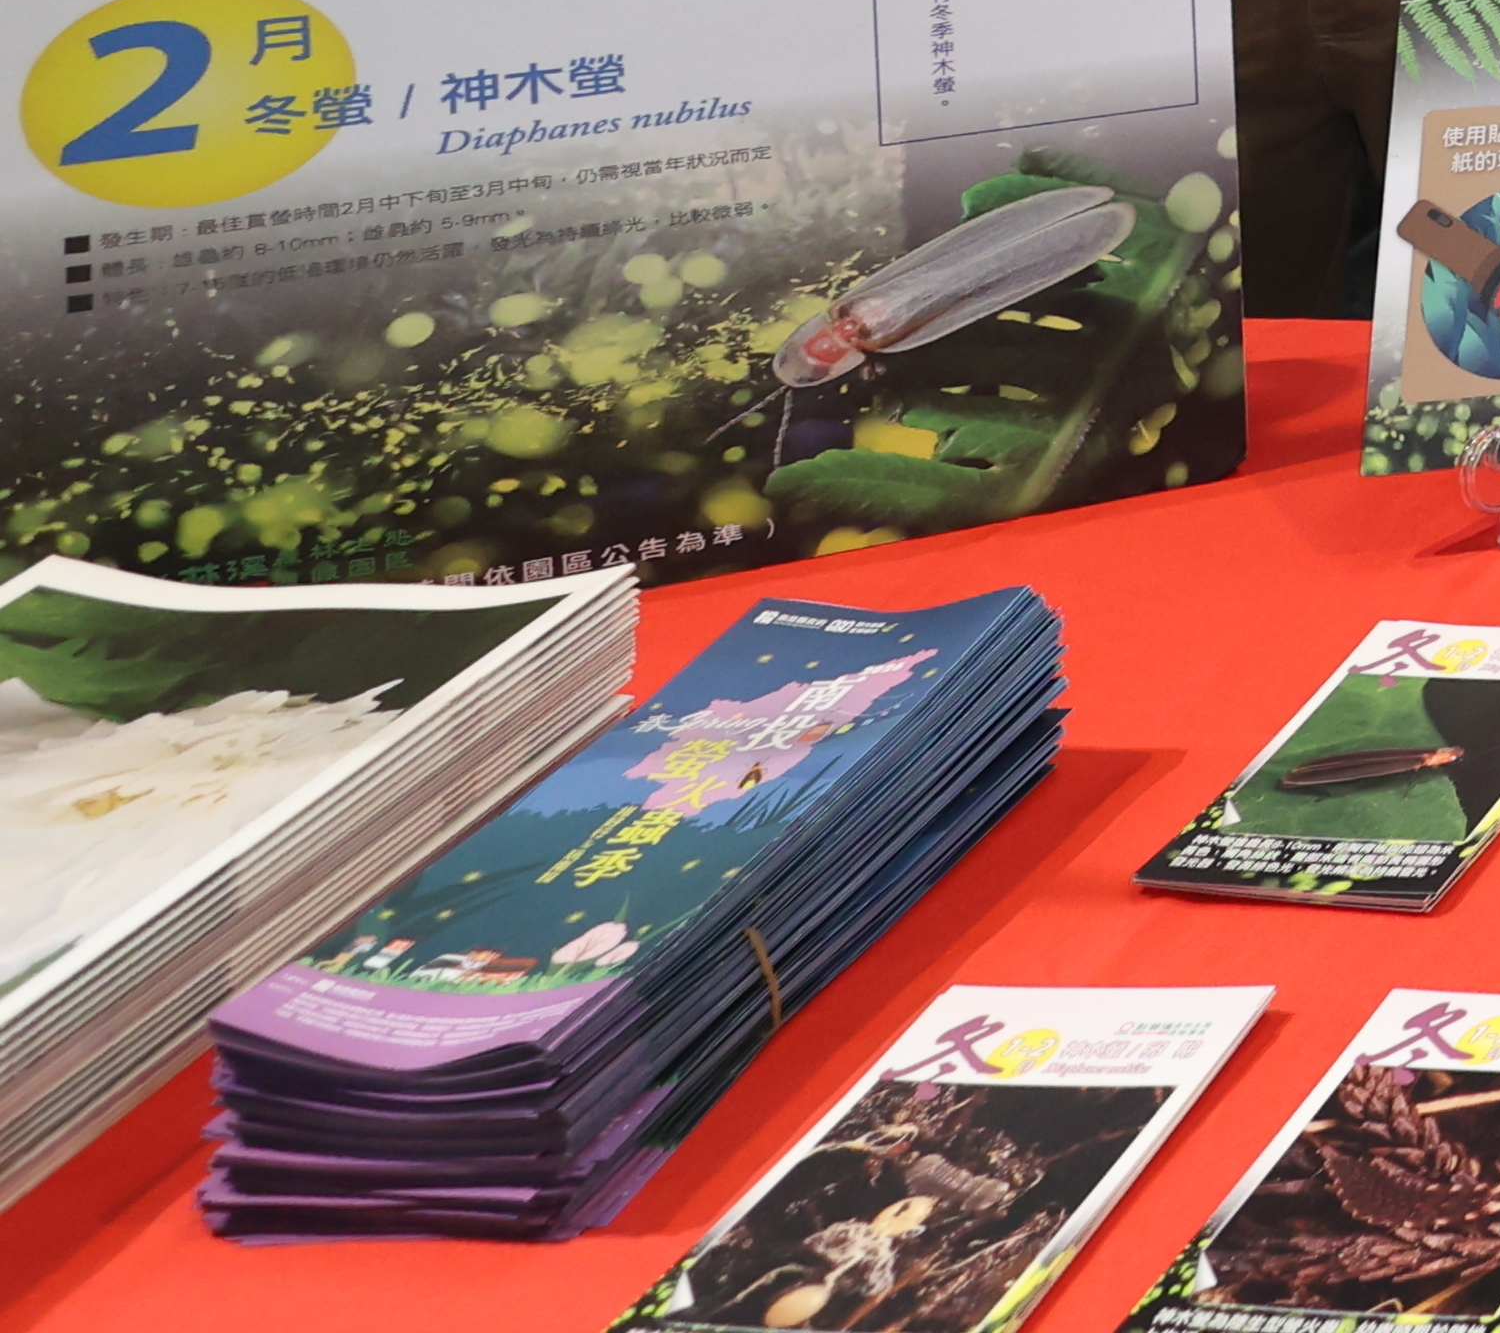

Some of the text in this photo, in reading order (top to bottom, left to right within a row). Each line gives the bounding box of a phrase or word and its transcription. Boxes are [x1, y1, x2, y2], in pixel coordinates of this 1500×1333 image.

[243, 81, 374, 137] 冬螢
[439, 53, 627, 117] 神木螢
[436, 95, 753, 157] Diaphanes nubilus
[1348, 628, 1447, 689] 冬
[736, 674, 868, 752] 南投
[573, 738, 740, 889] 螢火蟲季
[879, 1014, 1006, 1101] 冬
[1353, 1001, 1475, 1086] 冬
